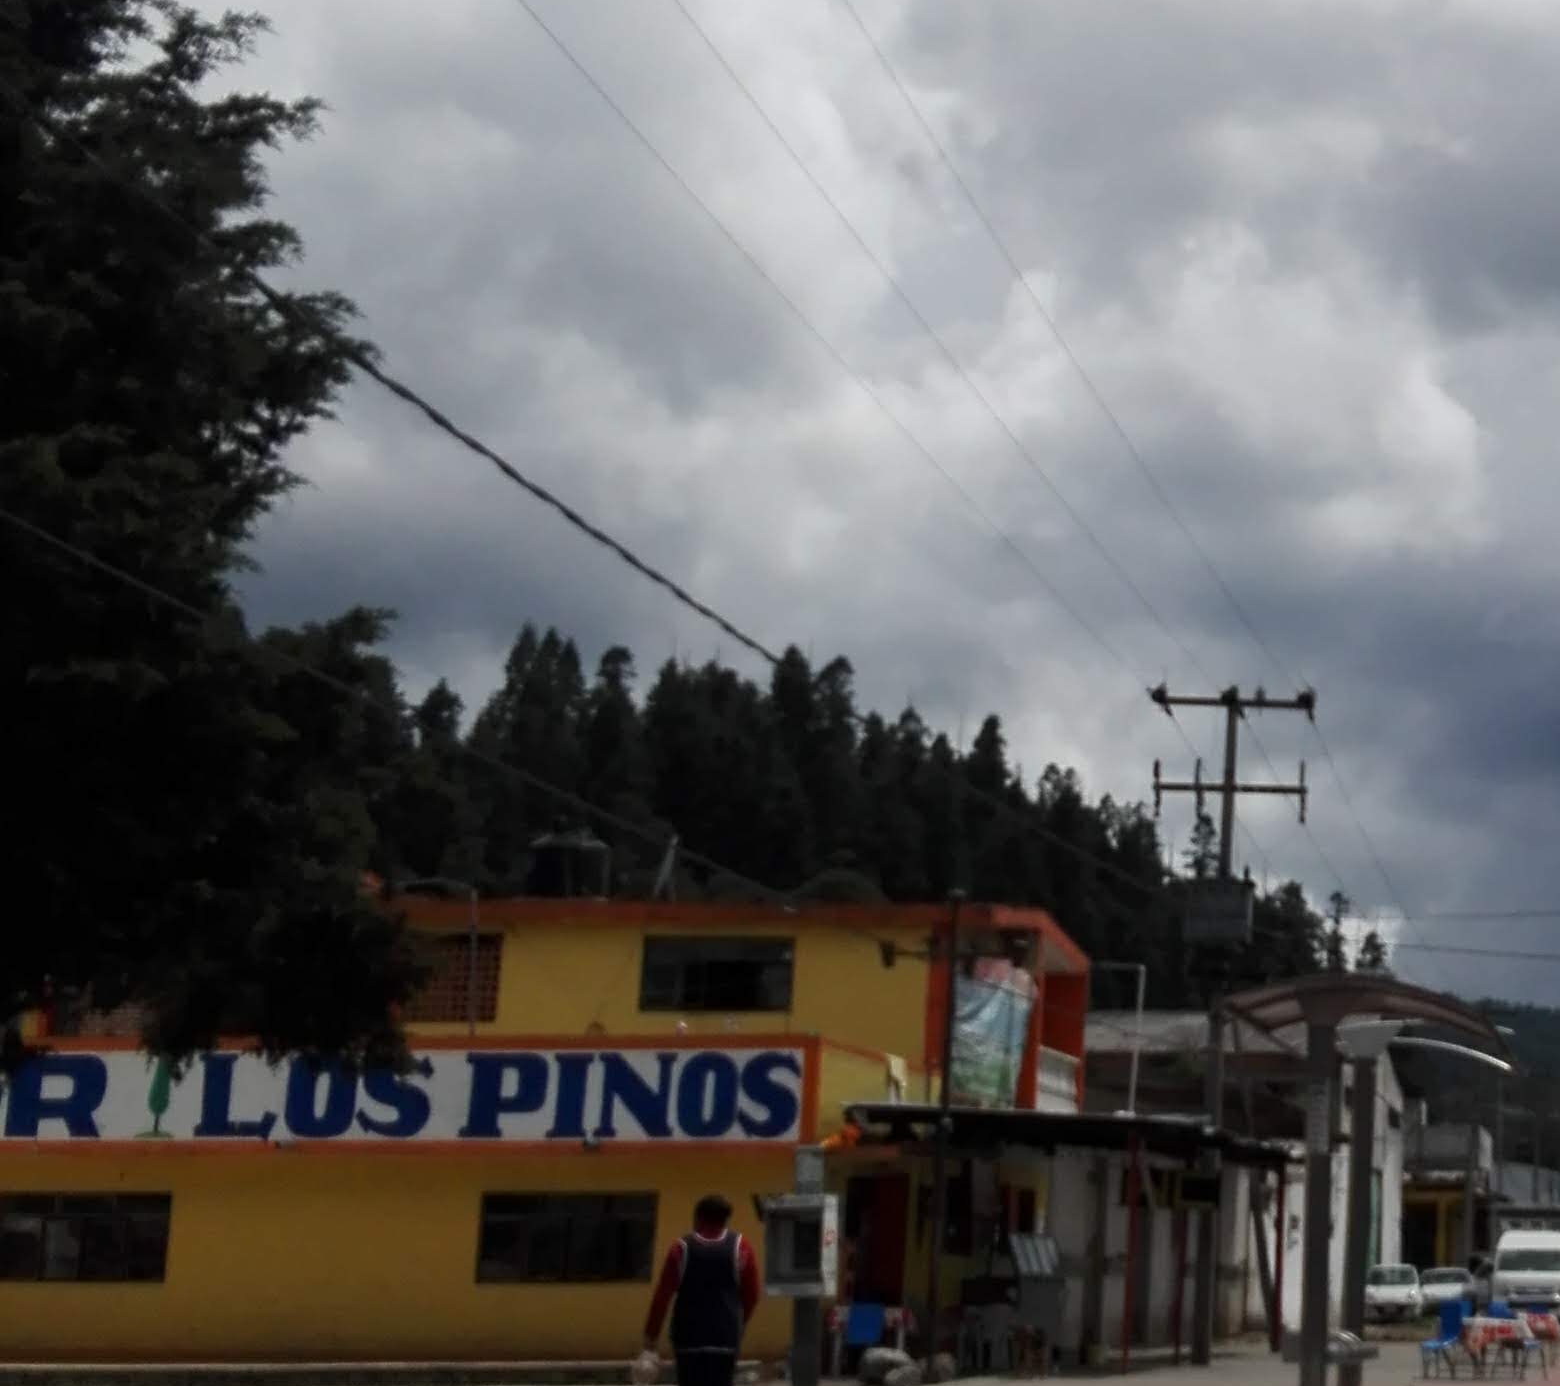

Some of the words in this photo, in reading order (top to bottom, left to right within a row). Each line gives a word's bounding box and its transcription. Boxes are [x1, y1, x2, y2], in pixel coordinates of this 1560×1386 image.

[0, 1054, 108, 1138] R
[194, 1053, 434, 1139] LOS
[457, 1051, 801, 1138] PINOS
